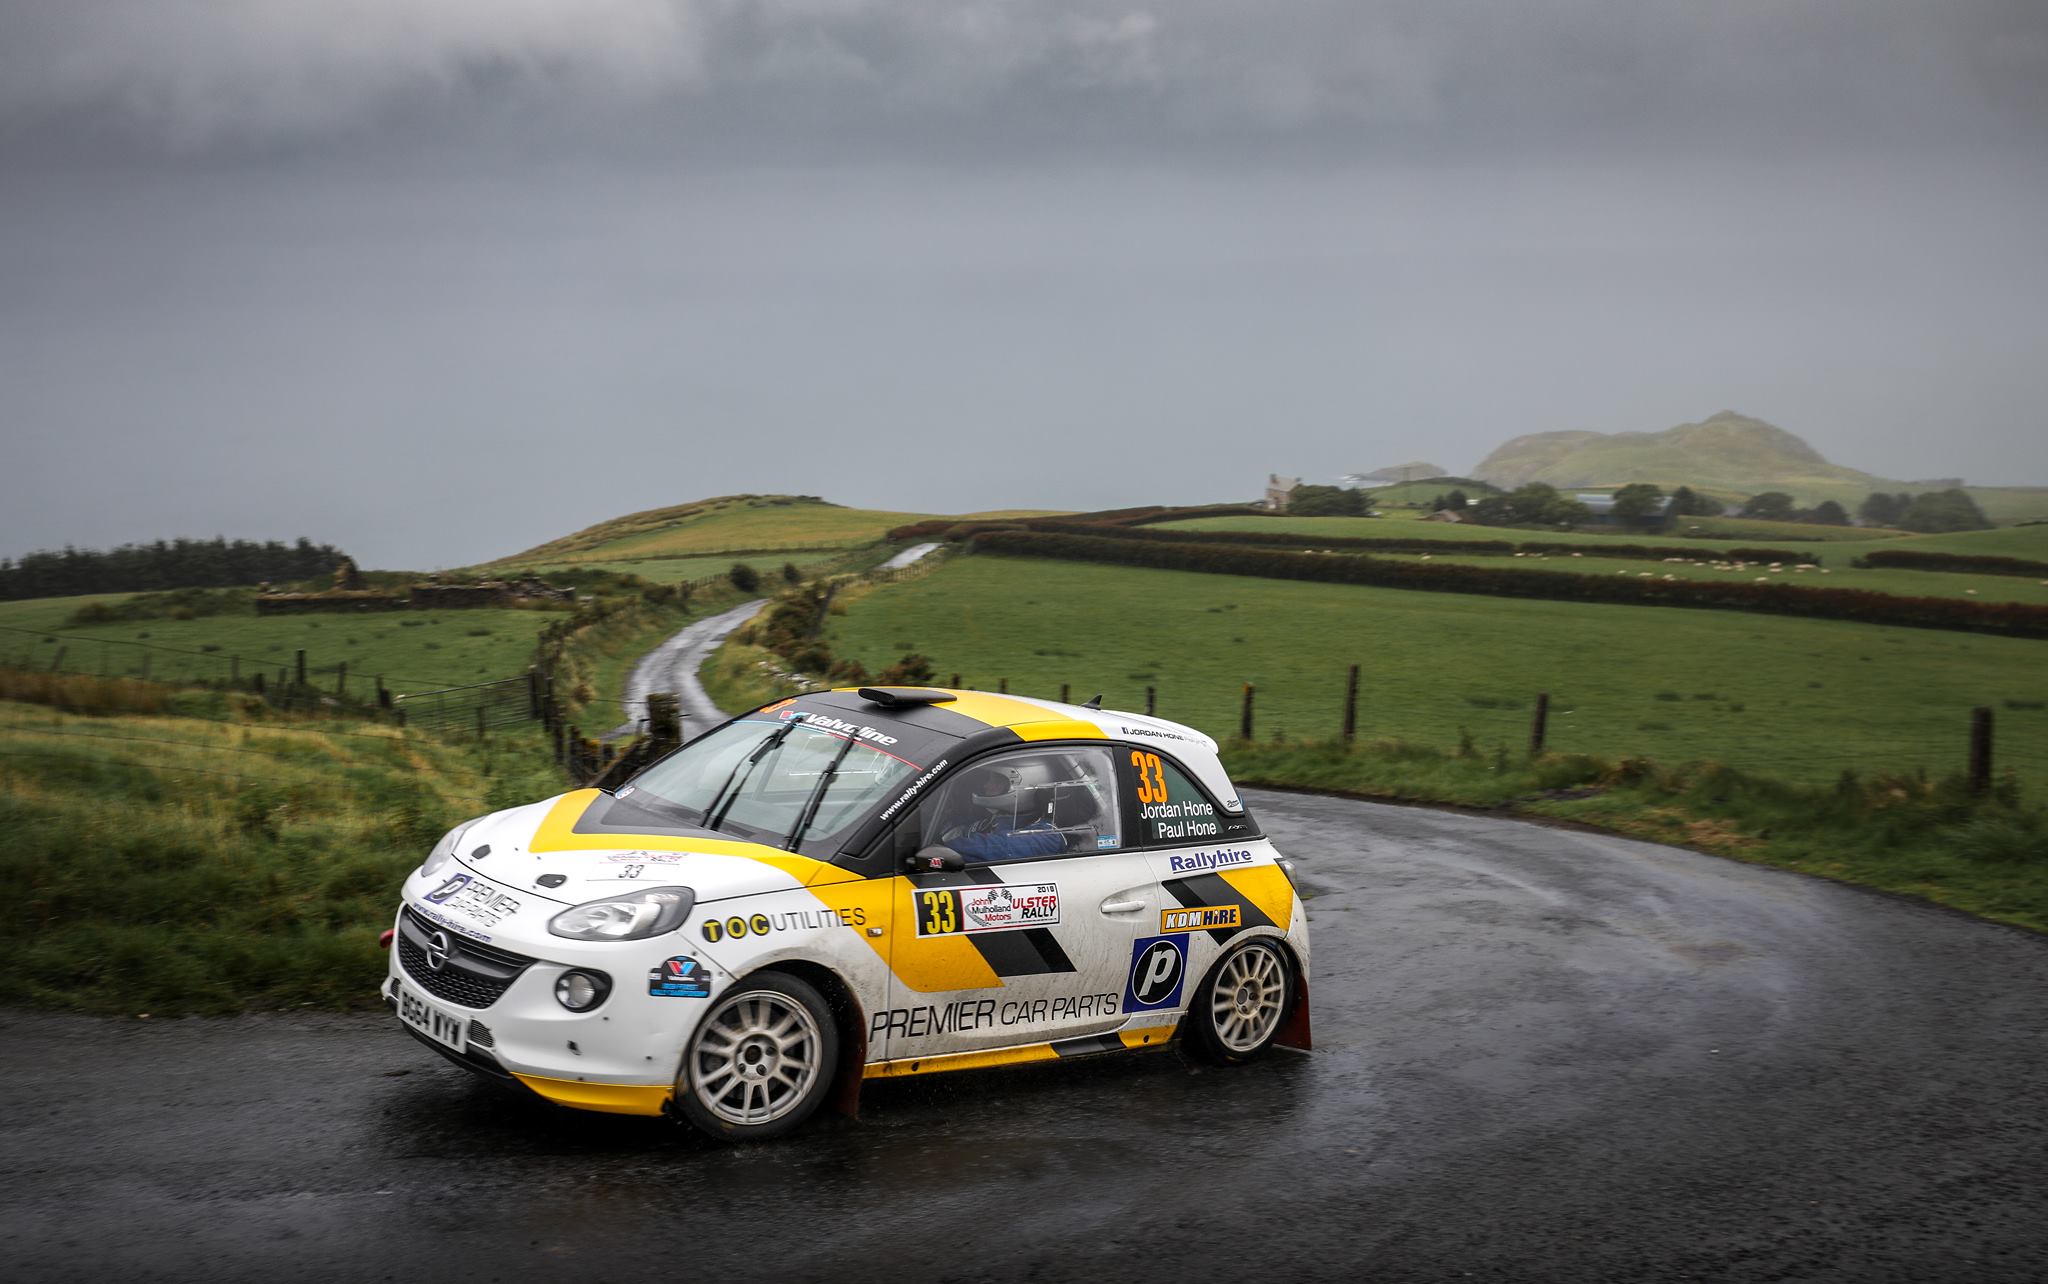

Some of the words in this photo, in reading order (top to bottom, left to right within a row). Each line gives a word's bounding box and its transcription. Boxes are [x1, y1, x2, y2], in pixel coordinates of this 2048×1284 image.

[1130, 729, 1163, 738] JORDAN
[1131, 751, 1168, 803] 33
[880, 759, 948, 820] www.rally-hire.com
[1140, 803, 1182, 819] Jordan
[1182, 800, 1214, 816] Hone
[1157, 822, 1185, 839] Paul
[1186, 821, 1217, 836] Hone
[1169, 848, 1253, 872] Rallyhire
[616, 864, 646, 879] 33
[971, 898, 992, 906] John
[971, 904, 1012, 914] Mulholland
[1012, 895, 1057, 909] ULSTER
[923, 891, 956, 934] 33
[984, 913, 1012, 921] Motors
[1021, 904, 1057, 919] RALLY
[868, 999, 996, 1043] PREMIER
[1001, 1000, 1048, 1026] CAR
[1051, 992, 1119, 1020] PARTS
